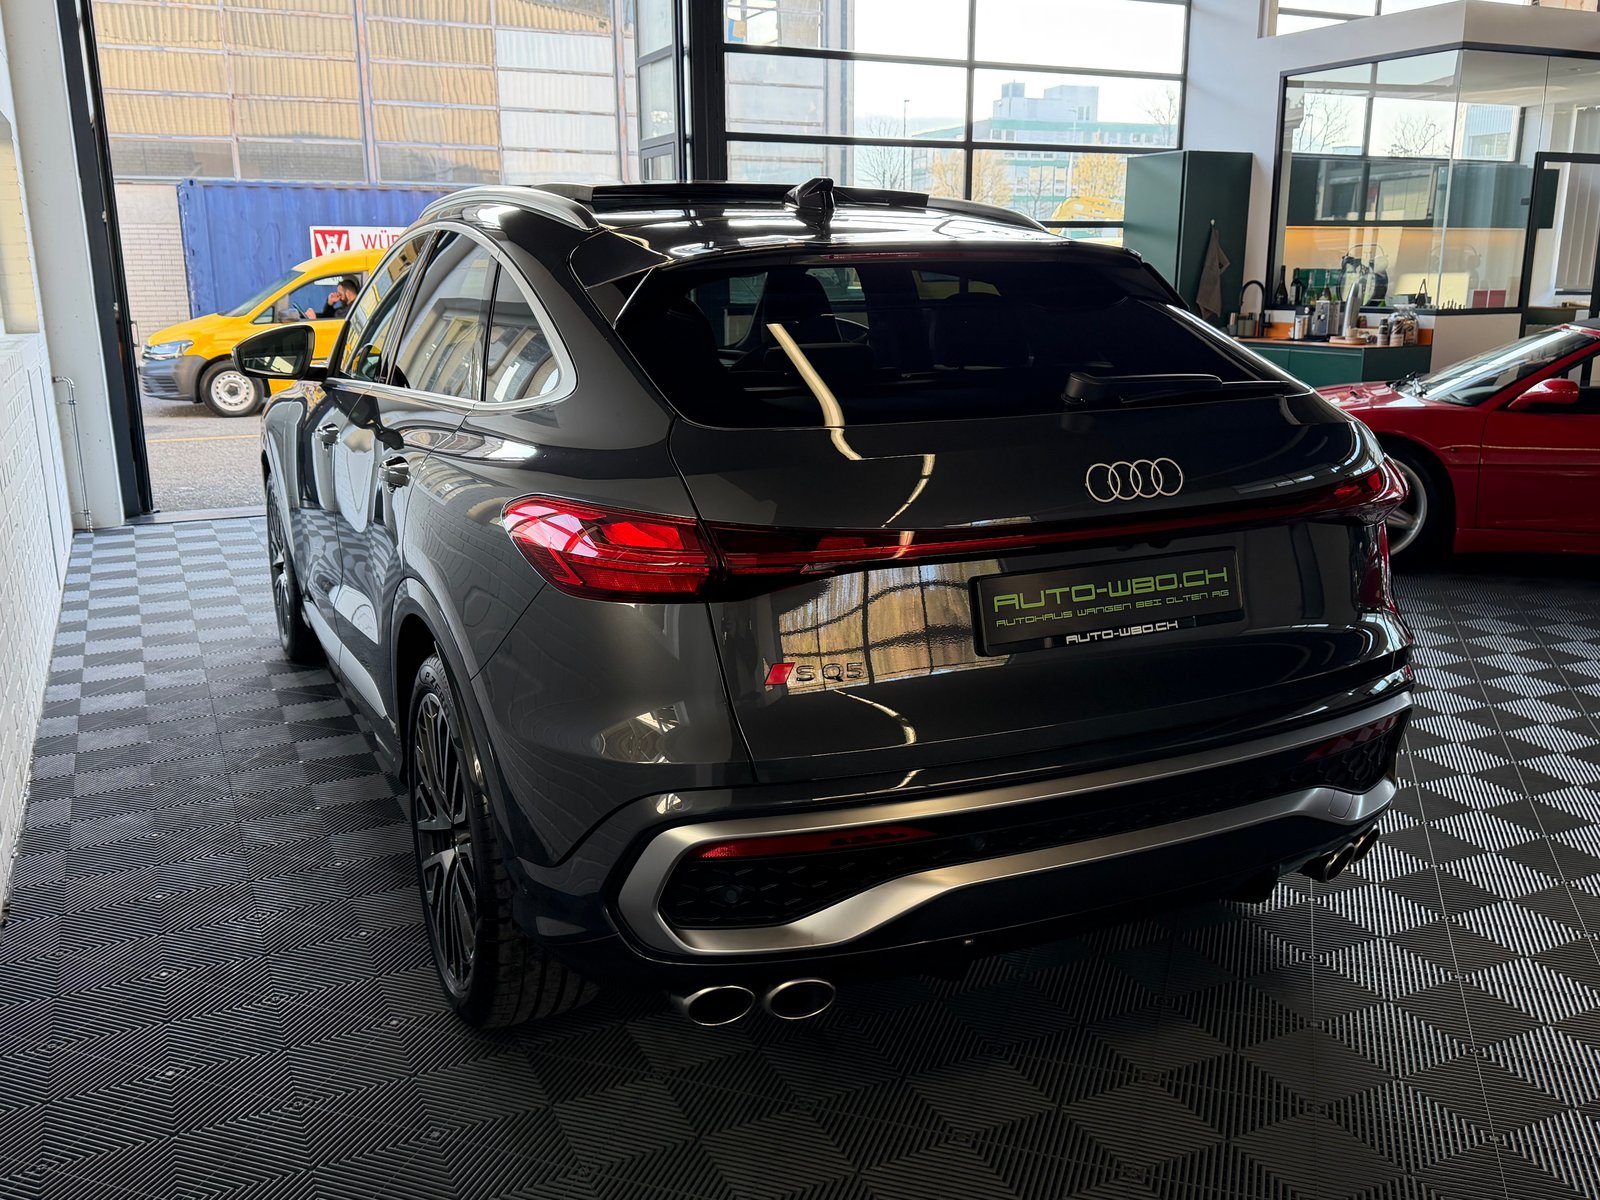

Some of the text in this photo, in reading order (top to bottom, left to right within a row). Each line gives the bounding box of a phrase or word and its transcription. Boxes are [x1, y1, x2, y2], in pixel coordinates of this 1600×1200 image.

[996, 610, 1073, 628] AUTOHAUS
[1135, 598, 1162, 609] BEI
[1165, 592, 1208, 605] OLTEN
[1212, 589, 1230, 598] AG
